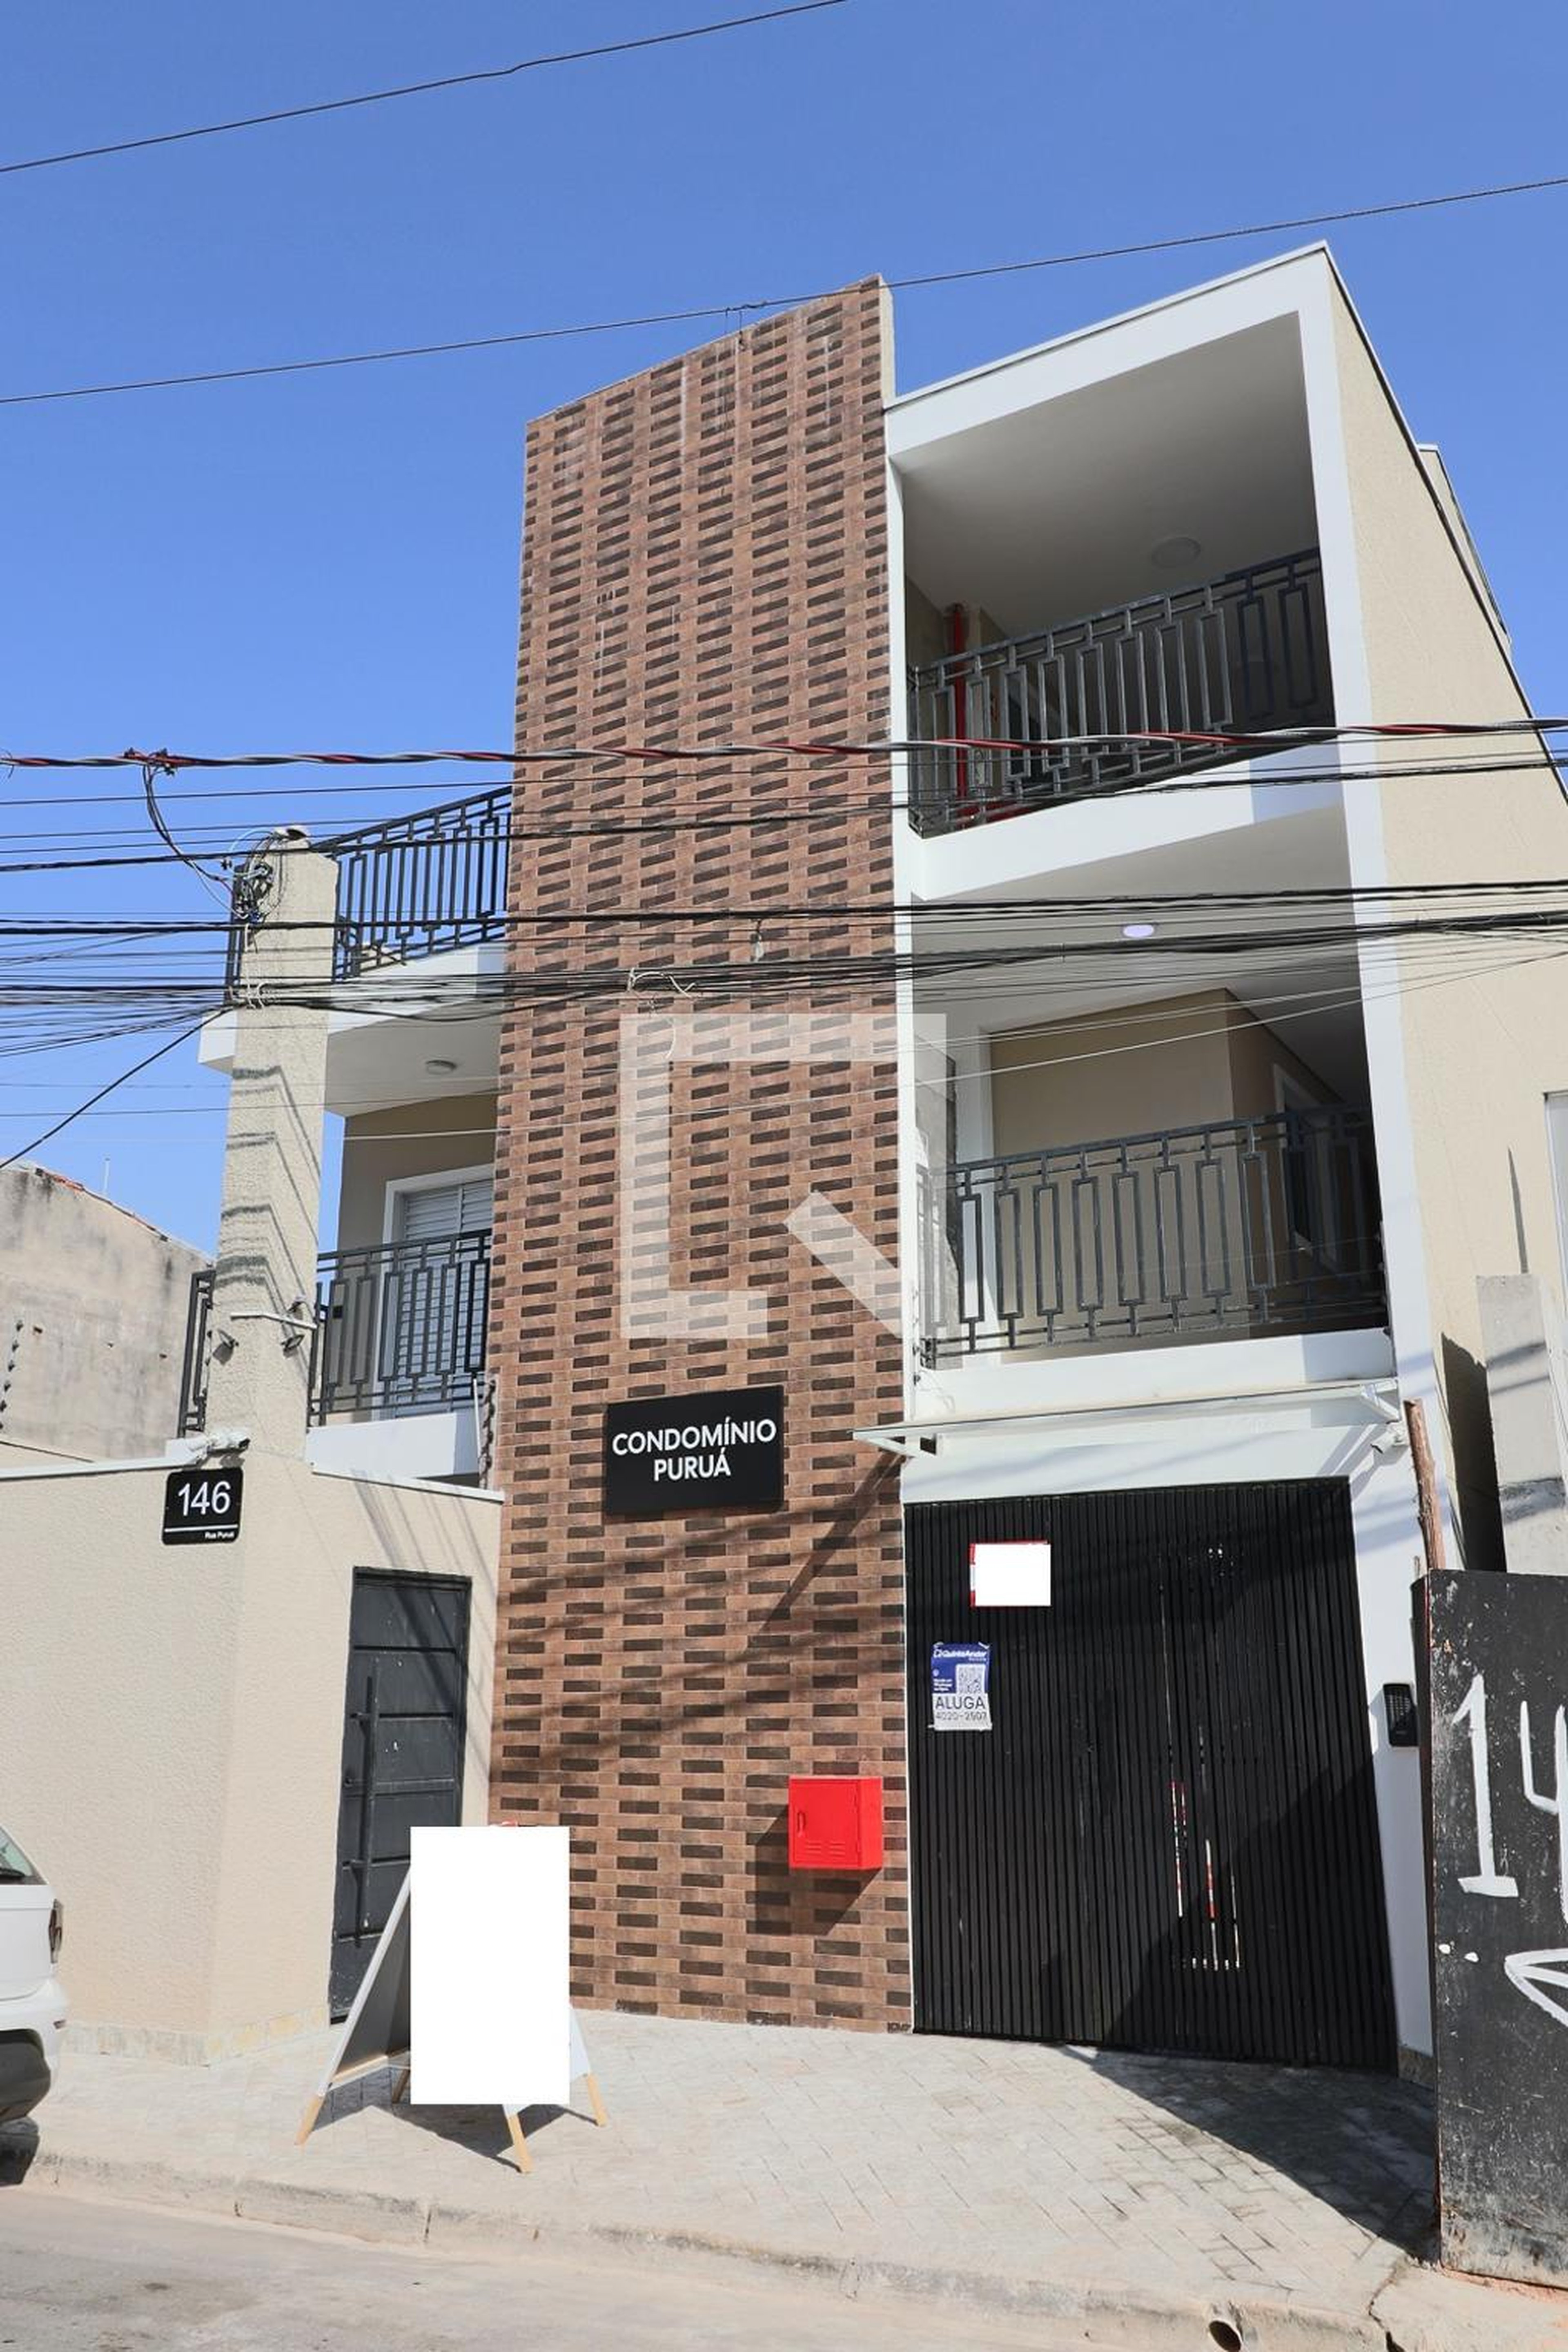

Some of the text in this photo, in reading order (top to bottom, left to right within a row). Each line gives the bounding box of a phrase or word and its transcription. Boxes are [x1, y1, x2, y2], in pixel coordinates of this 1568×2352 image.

[612, 1416, 777, 1456] CONDOMÍNIO
[654, 1447, 731, 1481] PURUÁ
[178, 1480, 231, 1516] 146
[935, 1696, 985, 1710] ALUGA
